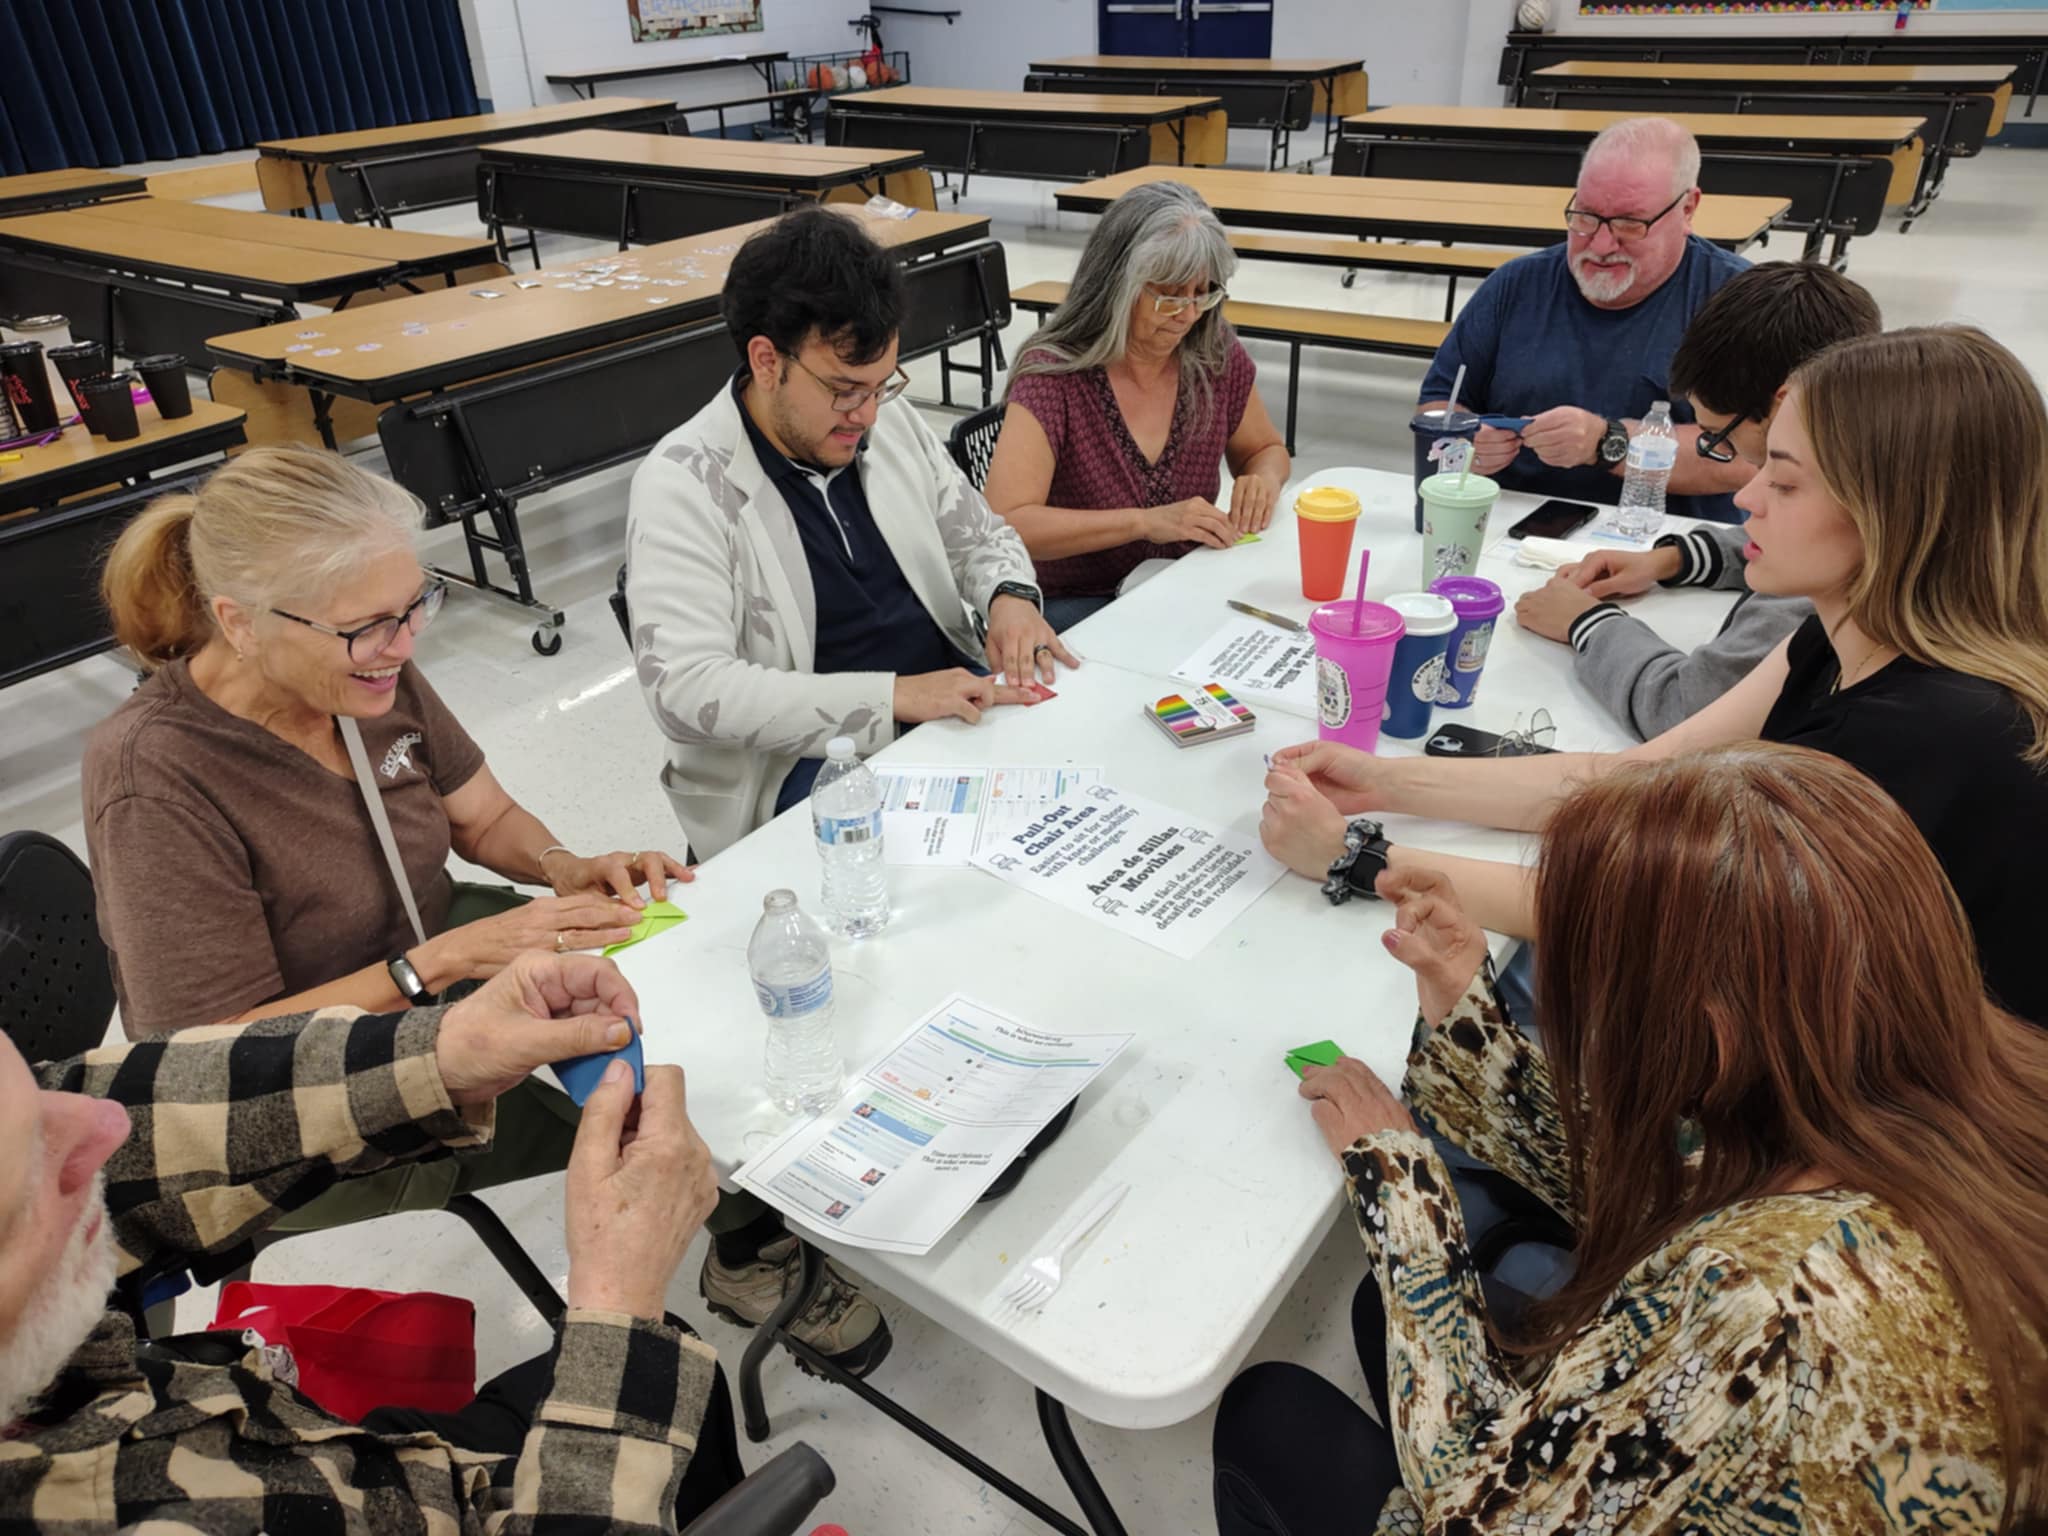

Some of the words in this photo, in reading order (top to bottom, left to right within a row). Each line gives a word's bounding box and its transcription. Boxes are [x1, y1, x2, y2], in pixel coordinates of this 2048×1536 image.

[1012, 805, 1072, 845] Pull-Out
[1024, 829, 1065, 856] Chair
[1062, 806, 1098, 830] Area
[1030, 850, 1062, 874] Easier
[1061, 843, 1075, 852] to
[1073, 833, 1089, 843] sit
[1084, 822, 1101, 834] for
[1099, 804, 1127, 823] those
[1043, 861, 1068, 878] with
[1063, 844, 1090, 862] knee
[1088, 834, 1102, 845] or
[1100, 808, 1140, 836] mobility
[1077, 830, 1128, 867] challenges.
[1121, 854, 1144, 869] de
[1137, 826, 1180, 855] Sillas
[1120, 843, 1185, 893] Movibles
[1151, 900, 1175, 920] para
[1172, 873, 1208, 901] quienes
[1203, 850, 1235, 874] tienen
[1154, 879, 1179, 899] fácil
[1175, 872, 1190, 882] de
[1187, 845, 1224, 873] sentarse
[1156, 898, 1196, 930] desafíos
[1191, 887, 1207, 899] de
[1203, 854, 1247, 889] movilidad
[1187, 906, 1203, 918] en
[1196, 896, 1215, 908] las
[1212, 870, 1249, 897] rodillas.
